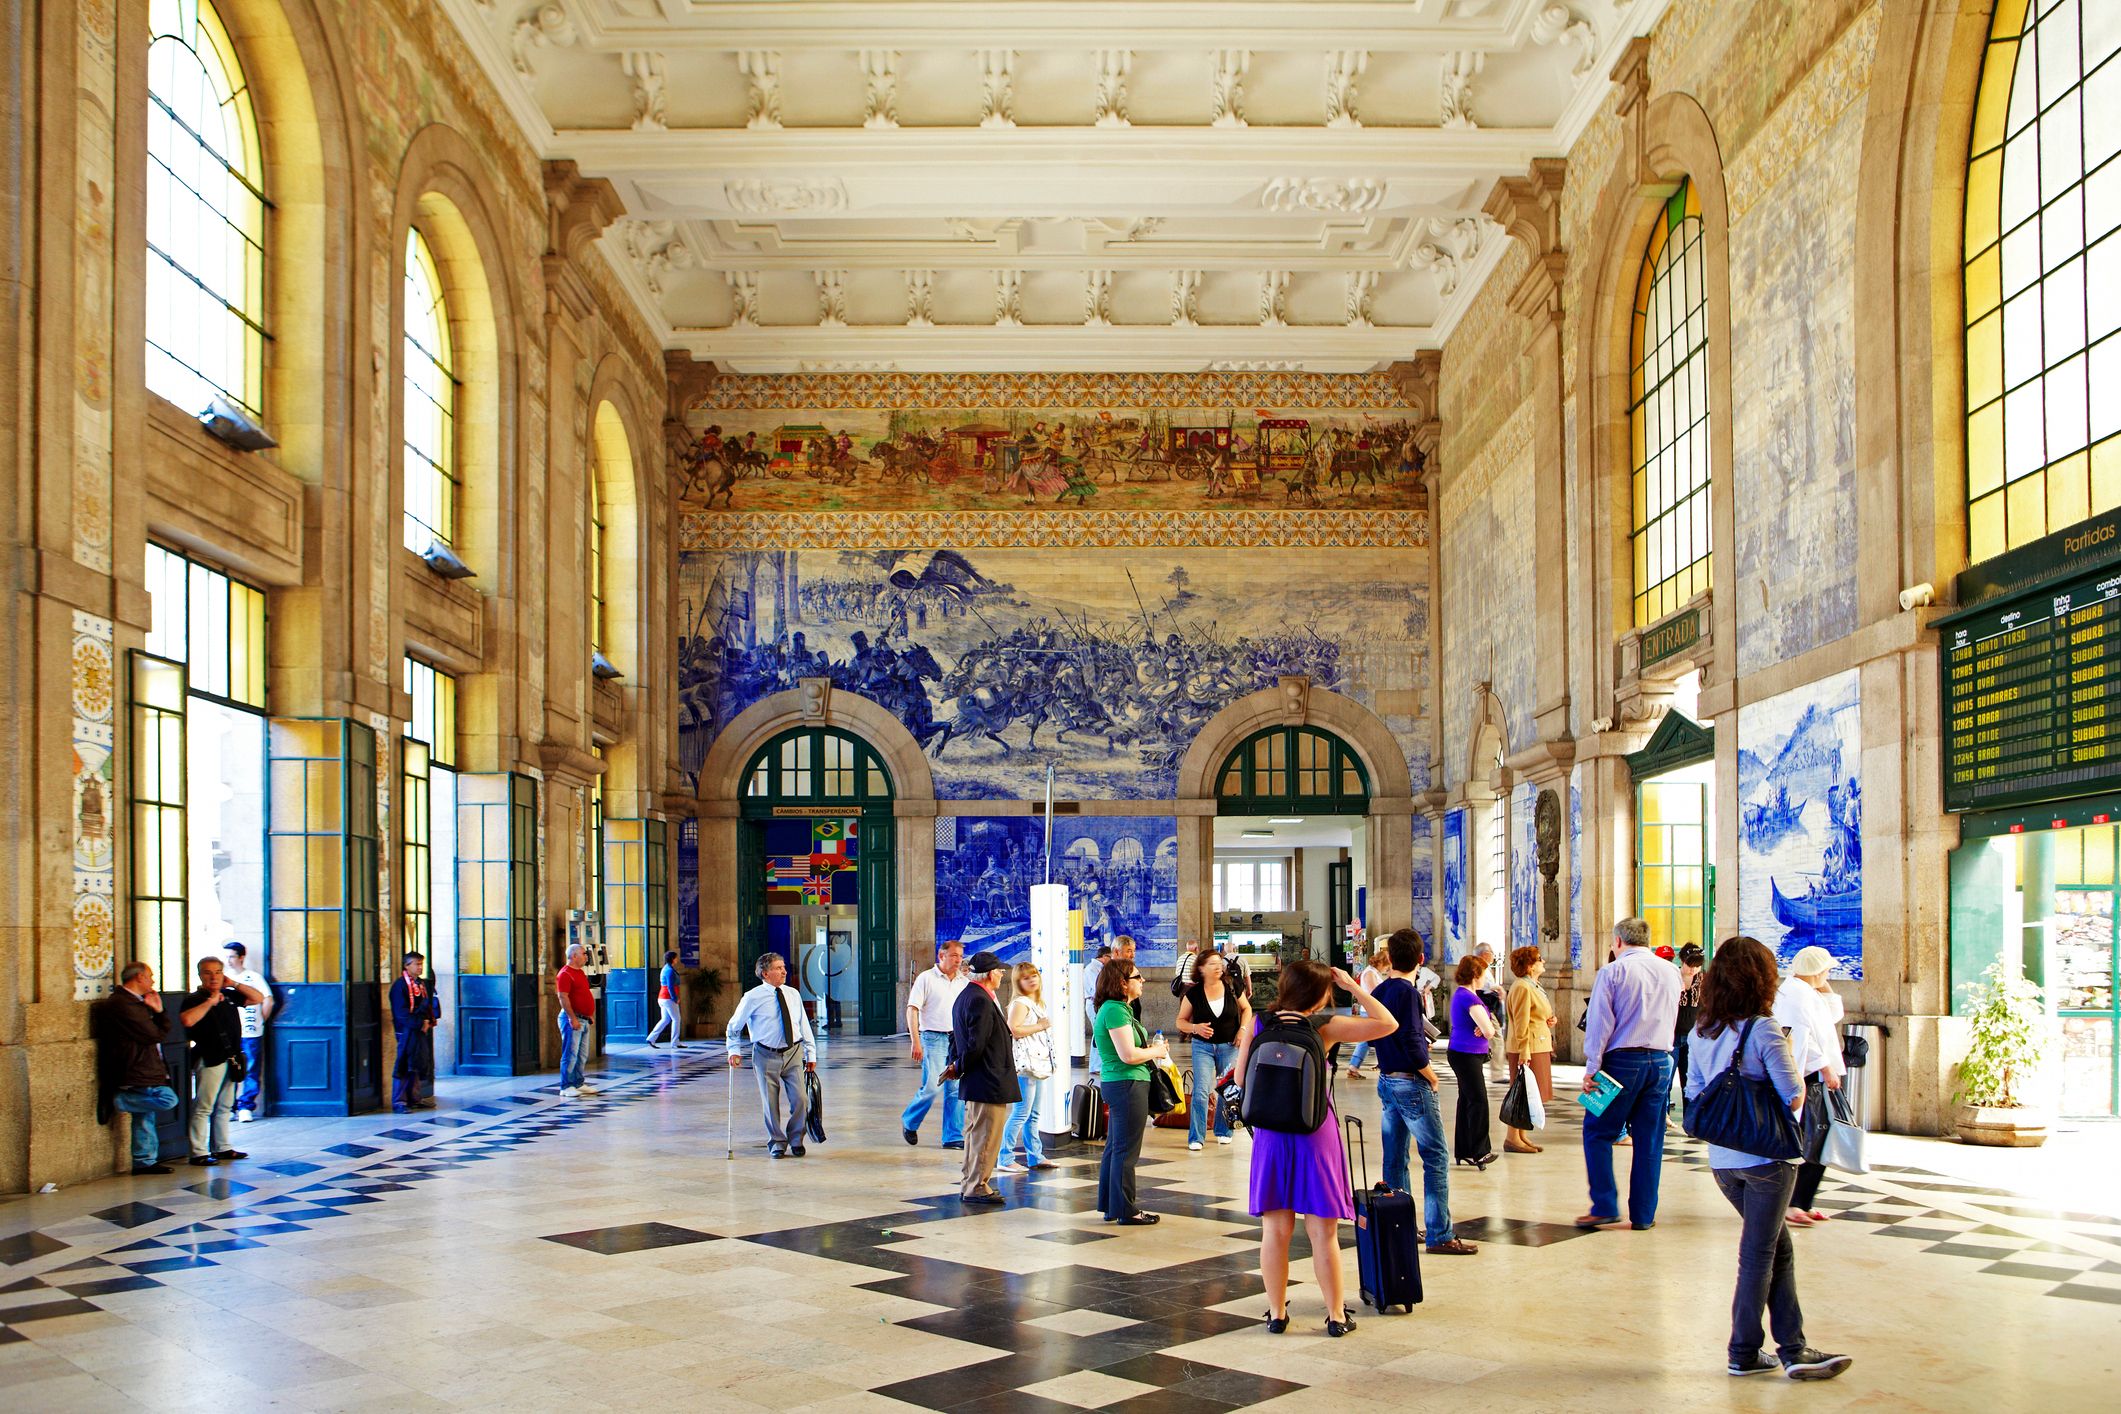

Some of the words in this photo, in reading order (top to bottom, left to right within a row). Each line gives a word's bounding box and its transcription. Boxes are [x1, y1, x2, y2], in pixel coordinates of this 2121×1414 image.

[2064, 524, 2115, 555] Partidas
[1955, 629, 1968, 640] hora
[2000, 611, 2021, 624] destino
[2053, 594, 2070, 606] linha
[2054, 604, 2070, 616] track
[2105, 588, 2118, 598] train
[1645, 616, 1696, 659] ENTRADA
[1976, 638, 1998, 655] SANTO
[2002, 629, 2026, 647] TIRSO
[2060, 617, 2066, 628] 4
[2071, 604, 2103, 626] SUBURB
[1977, 654, 2004, 673] AVEIRO
[2071, 624, 2103, 645] SUBURB
[1953, 698, 1974, 714] 12H15
[1977, 687, 2018, 708] GUIMARAES
[2072, 664, 2104, 685] SUBURB
[1977, 674, 1995, 691] OVAR
[2071, 644, 2104, 665] SUBURB
[1953, 716, 1974, 732] 12H25
[1977, 710, 2000, 726] BRAGA
[2072, 684, 2104, 704] SUBURB
[1977, 728, 2000, 744] CAIDE
[2072, 704, 2105, 724] SUBURB
[1977, 746, 2000, 762] BRAGA
[2072, 724, 2105, 743] SUBURB
[1977, 765, 1995, 780] OVAR
[2073, 744, 2105, 763] SUBURB
